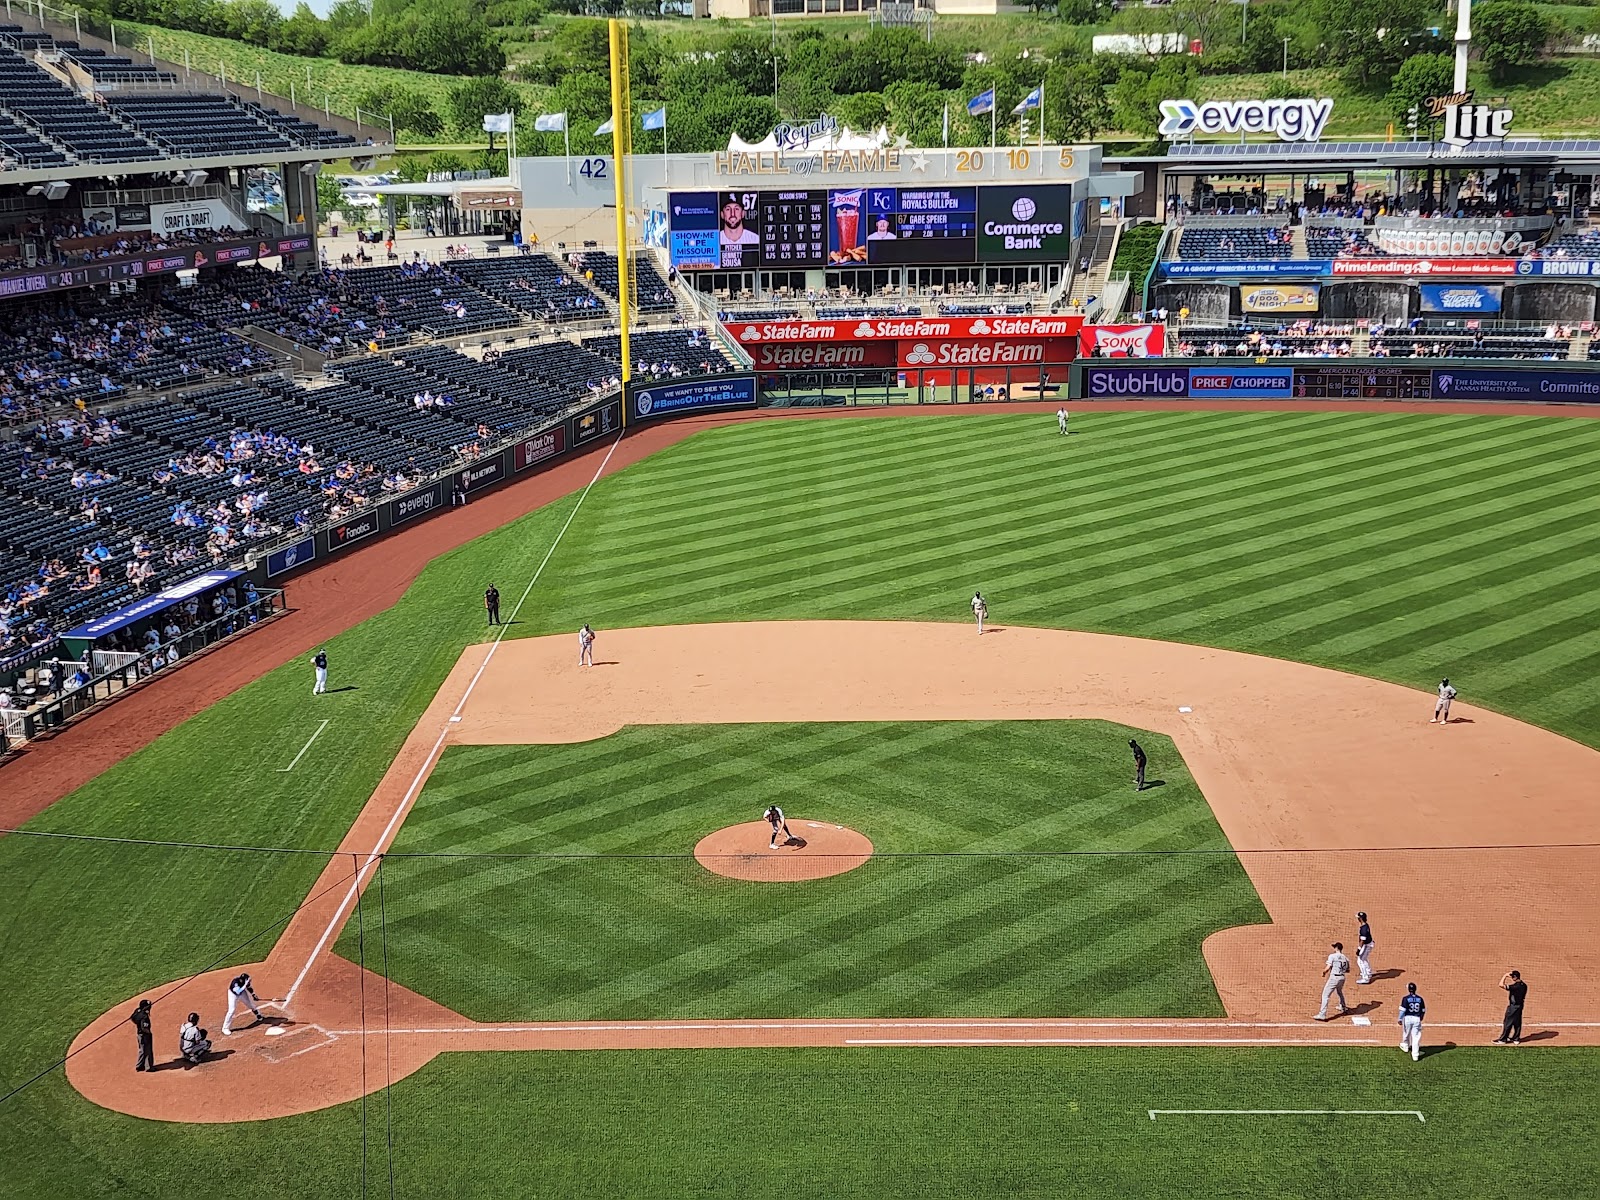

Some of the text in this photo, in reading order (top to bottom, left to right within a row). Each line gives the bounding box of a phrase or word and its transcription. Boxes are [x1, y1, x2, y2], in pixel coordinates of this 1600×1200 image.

[1424, 93, 1472, 117] Miller
[1203, 103, 1327, 136] evergy
[1440, 105, 1514, 147] Lite
[773, 112, 839, 152] Royals
[714, 149, 902, 179] HALL of FAME
[955, 150, 984, 172] 20
[1006, 149, 1030, 171] 10
[1058, 147, 1075, 169] 5
[579, 158, 607, 180] 42
[742, 193, 757, 210] 67
[873, 192, 891, 210] KC
[902, 199, 959, 210] ROYALS BULLPEN
[164, 212, 210, 229] CRAFT & DRAFT
[898, 215, 948, 224] 67 GABE SPEIER
[984, 221, 1063, 236] Commerce
[279, 239, 309, 251] PRICE CHOPPER
[1004, 236, 1042, 250] Bank
[217, 248, 250, 260] PRICE CHOPPER
[677, 247, 714, 255] MISSOURI
[148, 257, 185, 270] PRICE CHOPPER
[722, 258, 742, 267] SOUSA
[1334, 261, 1414, 275] PrimeLending
[1451, 265, 1471, 273] Loans
[1472, 265, 1490, 273] Made
[1542, 261, 1589, 274] BROWN
[26, 275, 48, 291] RIVERA
[1101, 337, 1143, 348] SONIC
[1091, 372, 1185, 394] StubHub
[1196, 377, 1287, 388] PRICE CHOPPER
[1351, 377, 1359, 385] 68
[1386, 377, 1392, 385] 6
[1421, 377, 1430, 385] 63
[1469, 379, 1508, 387] UNIVERSITY
[1540, 379, 1600, 395] Committe
[674, 389, 693, 397] WANT
[704, 385, 718, 393] SEE
[1316, 388, 1322, 396] 0
[1350, 388, 1359, 396] 44
[531, 434, 555, 451] Mark One
[478, 464, 497, 480] NETWORK
[407, 490, 434, 512] evergy
[345, 522, 370, 540] Fanatics
[1408, 1003, 1420, 1013] 39
